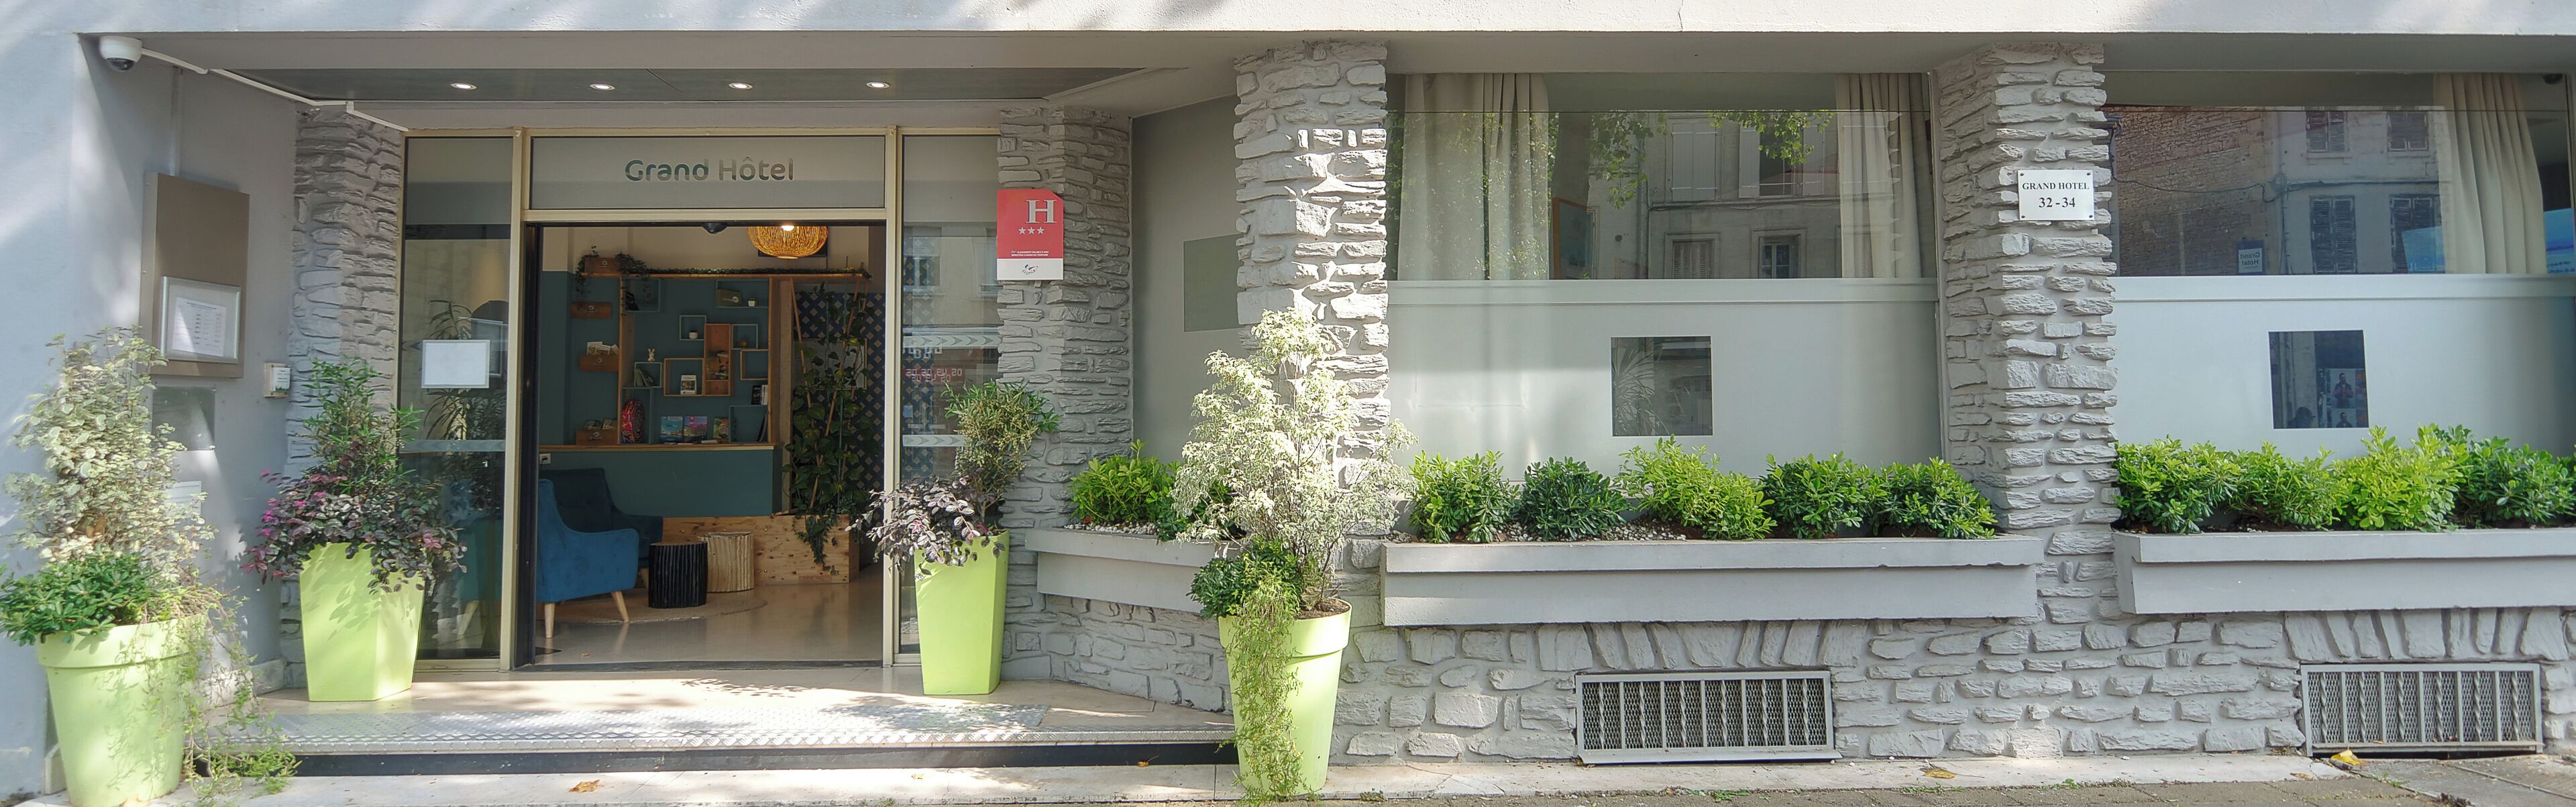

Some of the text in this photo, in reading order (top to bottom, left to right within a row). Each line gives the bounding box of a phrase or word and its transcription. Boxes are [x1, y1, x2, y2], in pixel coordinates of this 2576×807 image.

[625, 156, 794, 181] Grand Hôtel
[2022, 182, 2090, 190] GRAND HOTEL
[1025, 199, 1058, 224] H
